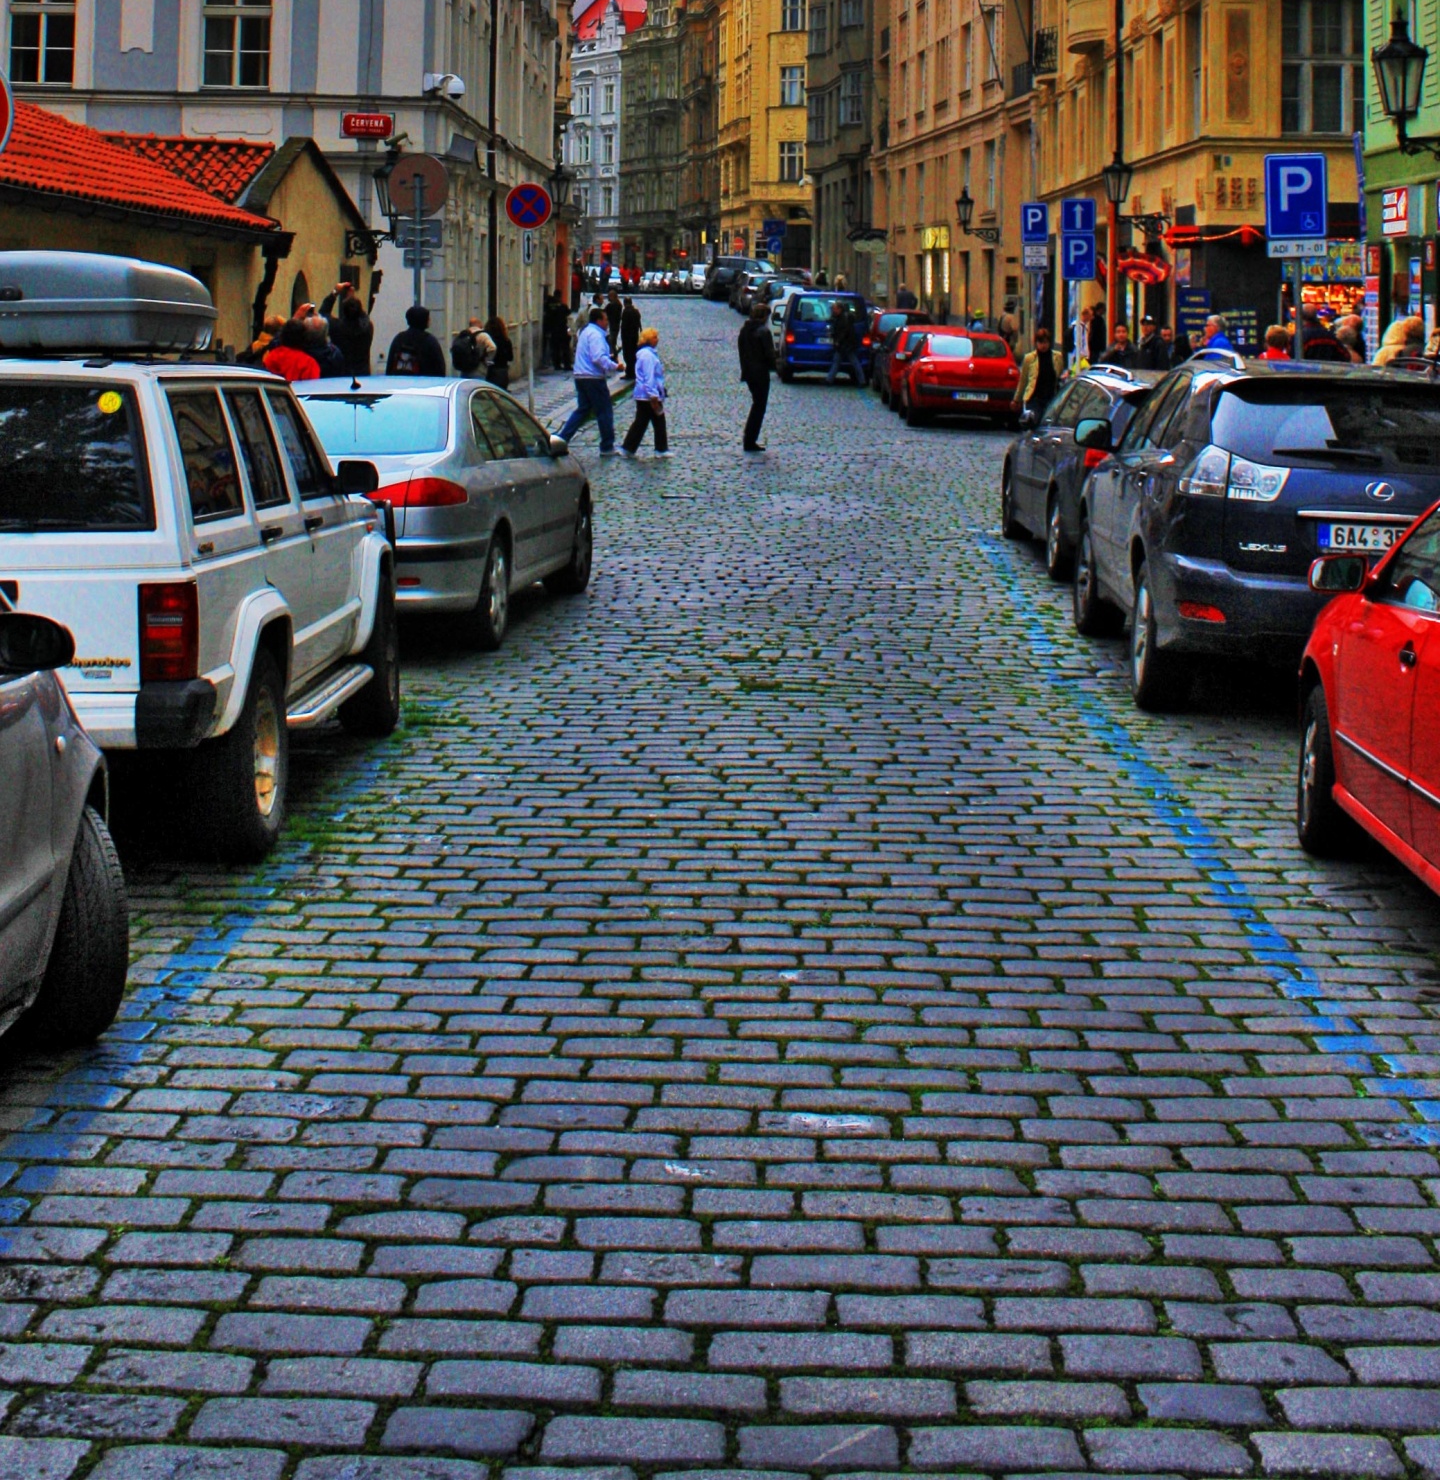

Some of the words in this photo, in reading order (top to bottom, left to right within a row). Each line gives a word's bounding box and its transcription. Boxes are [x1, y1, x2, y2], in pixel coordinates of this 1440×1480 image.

[350, 117, 384, 127] ČERVENÁ
[1280, 166, 1312, 212] P
[1027, 208, 1042, 231] P
[1069, 239, 1088, 265] P
[1295, 244, 1305, 252] 71
[1334, 527, 1368, 547] 6A4
[1239, 542, 1287, 552] LEXUS
[70, 656, 131, 668] herokee
